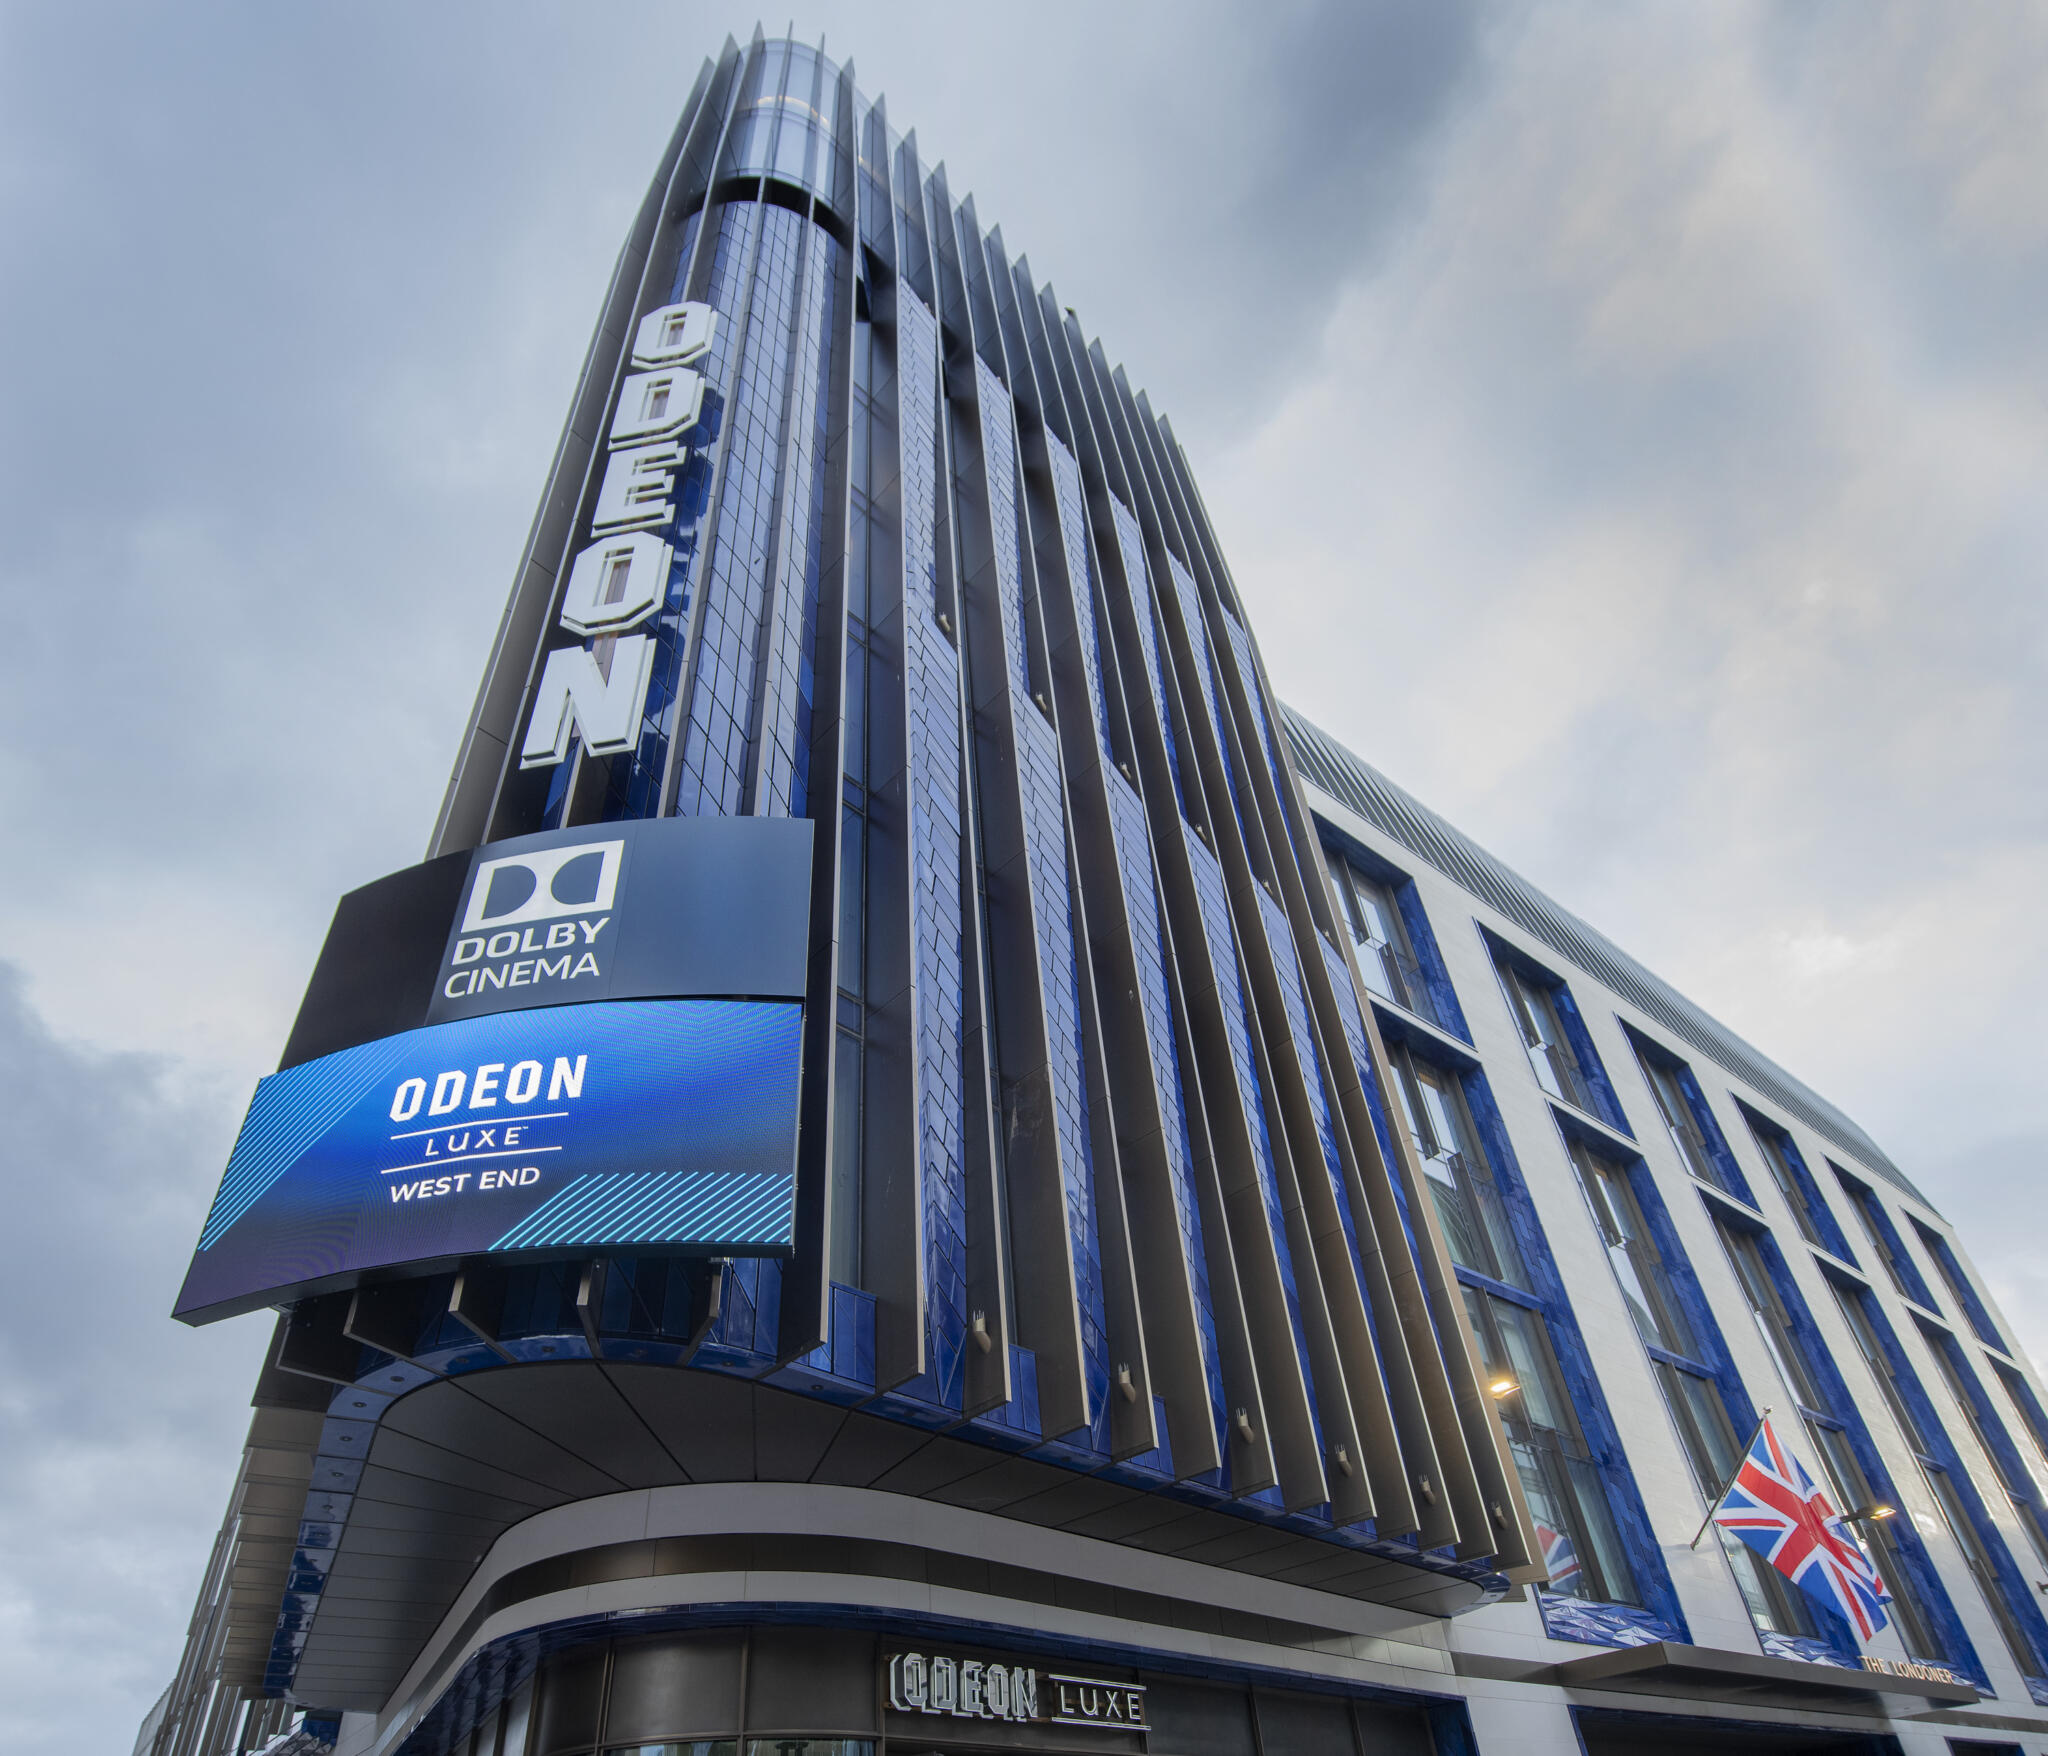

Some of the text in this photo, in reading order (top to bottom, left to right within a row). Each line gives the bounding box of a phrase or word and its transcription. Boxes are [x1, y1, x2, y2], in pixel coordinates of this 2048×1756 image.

[520, 300, 717, 770] ODEON
[452, 917, 610, 966] DOLBY
[444, 952, 600, 999] CINEMA
[389, 1054, 587, 1122] ODEON
[425, 1126, 522, 1157] LUXE
[390, 1166, 541, 1203] WEST END
[889, 1652, 1142, 1723] ODEON LUXE
[1860, 1656, 1953, 1684] THE LONDONER
